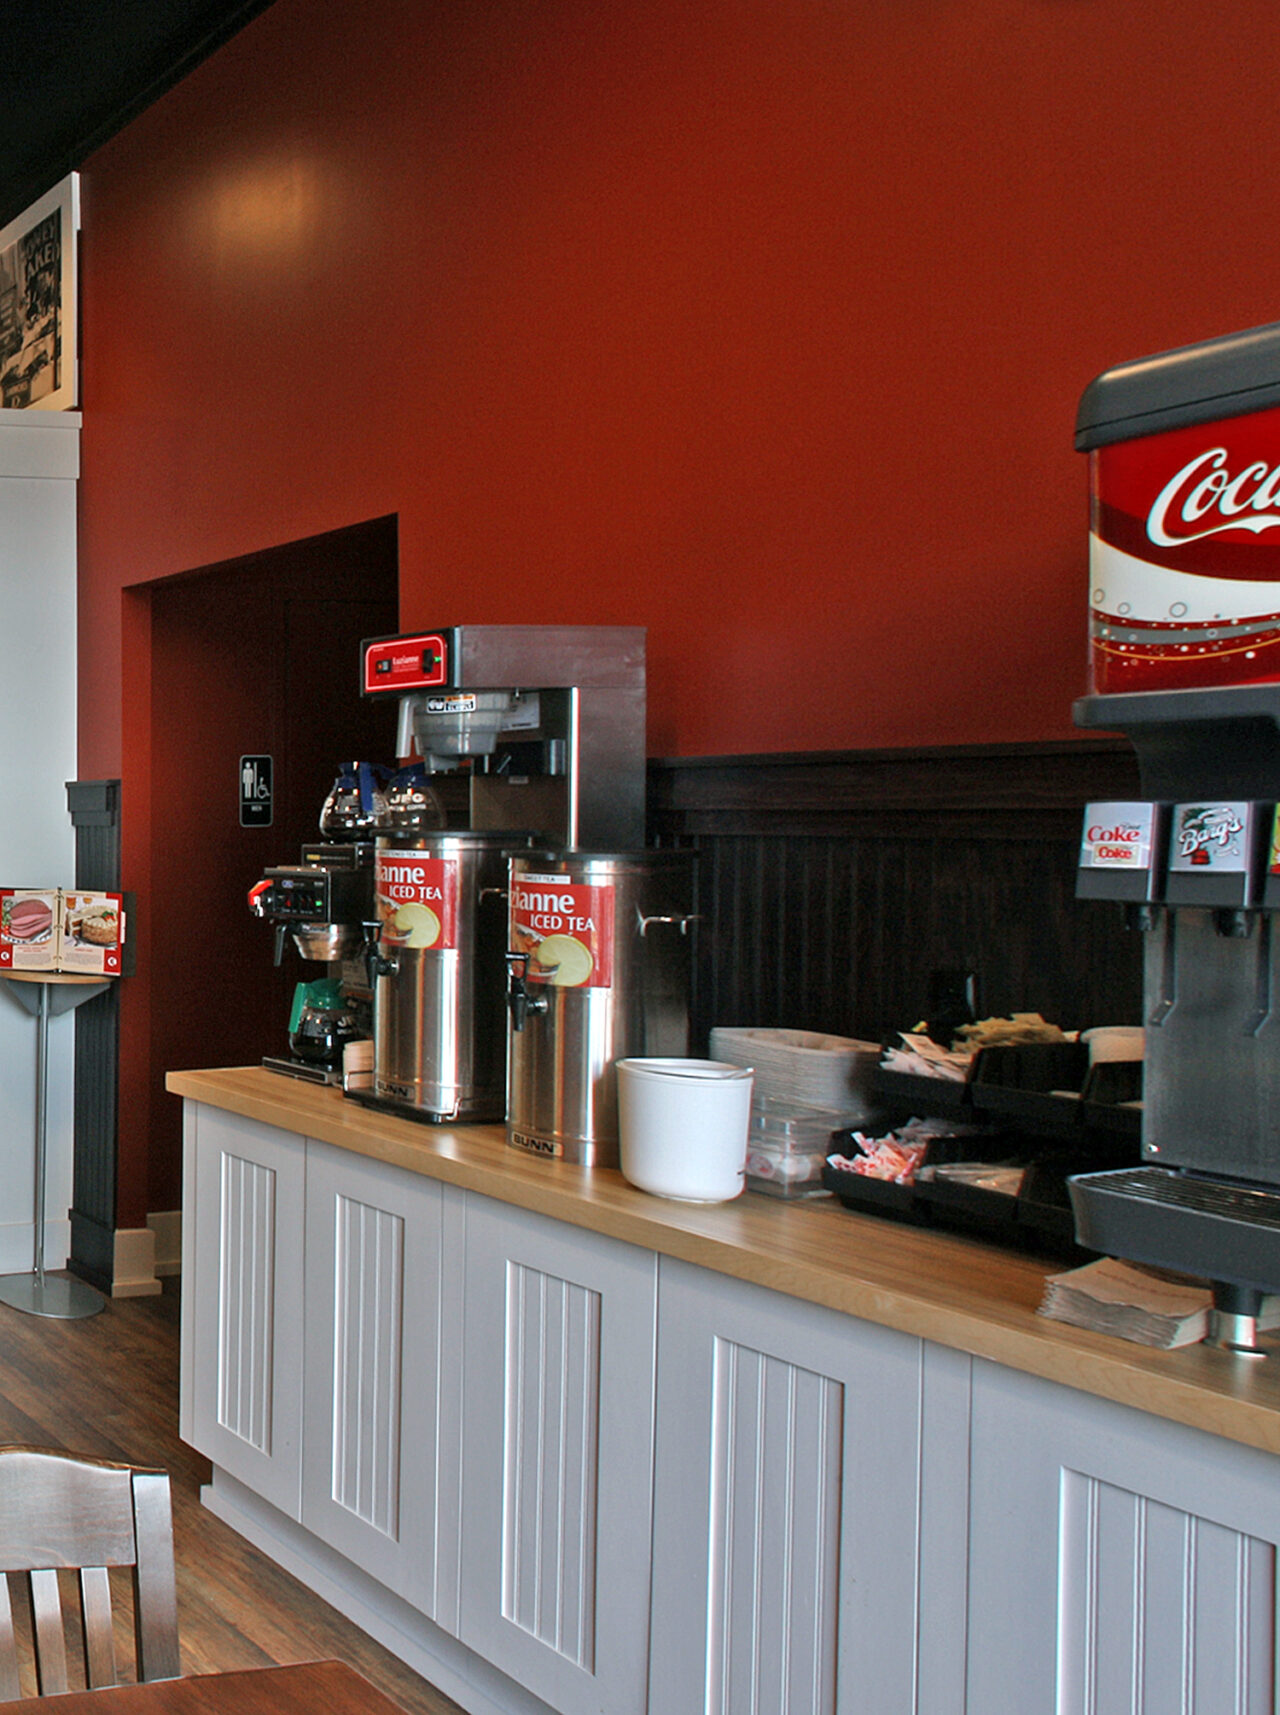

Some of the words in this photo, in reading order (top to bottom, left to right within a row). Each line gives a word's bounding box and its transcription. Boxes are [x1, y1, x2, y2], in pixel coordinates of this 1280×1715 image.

[1087, 824, 1141, 843] Coke
[1098, 845, 1133, 860] Coke
[389, 884, 416, 899] ICED
[418, 886, 443, 900] TEA
[530, 913, 563, 930] ICED
[566, 916, 597, 932] TEA
[513, 1133, 556, 1153] BUNN
